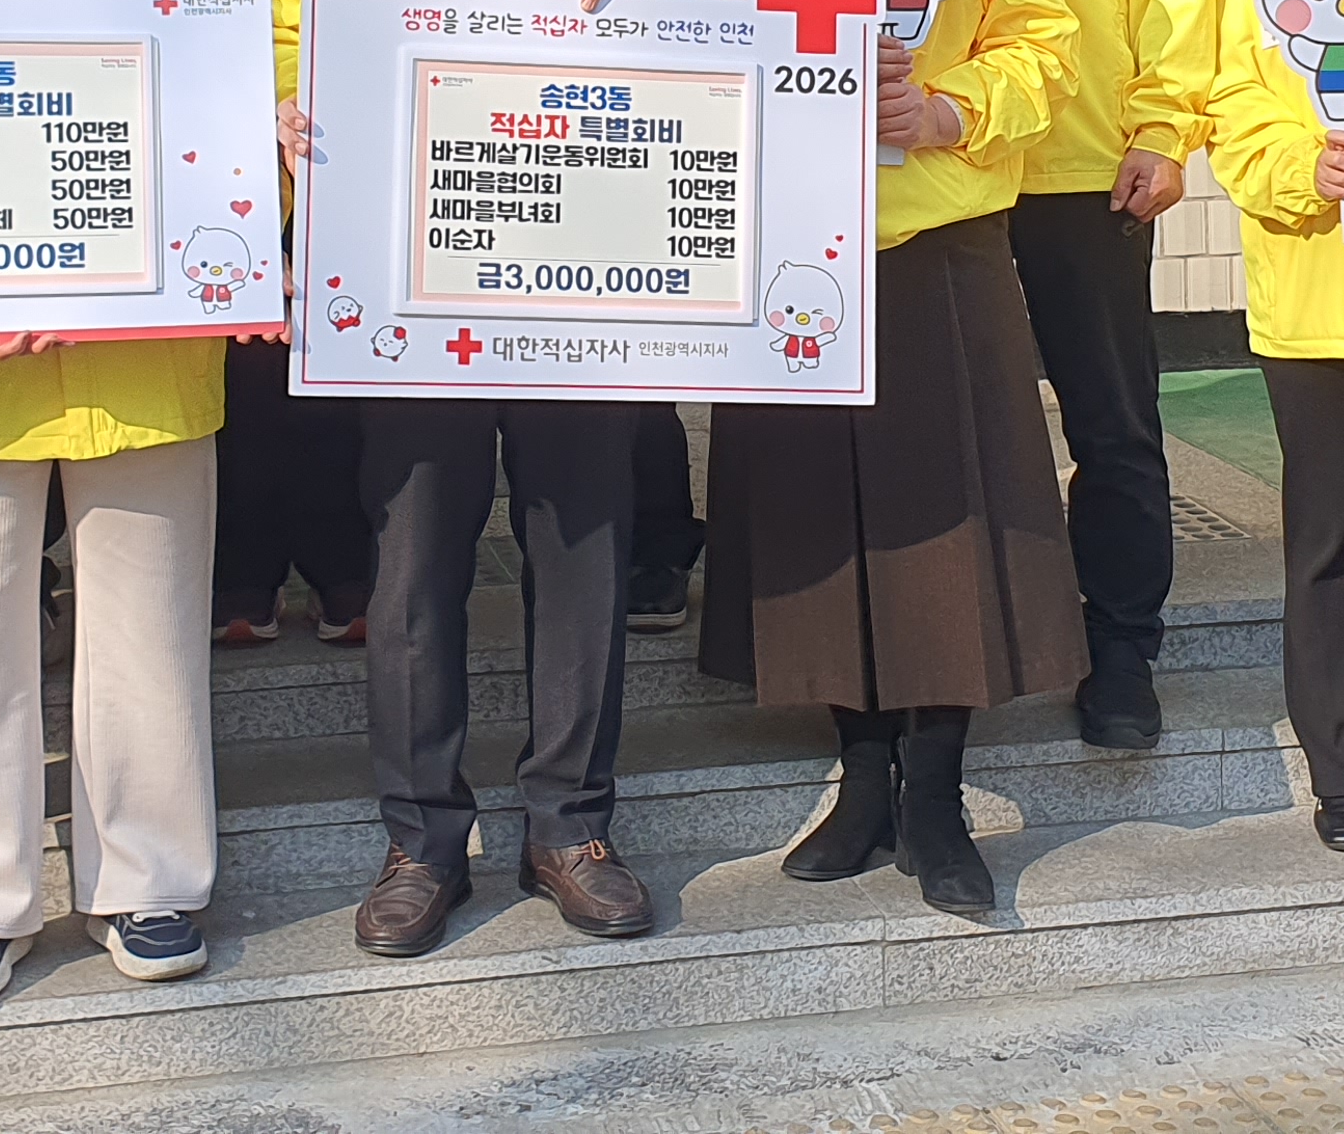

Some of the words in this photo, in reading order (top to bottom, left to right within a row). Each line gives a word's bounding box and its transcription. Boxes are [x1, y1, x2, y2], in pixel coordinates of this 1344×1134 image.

[400, 6, 458, 35] 생명을
[467, 10, 524, 36] 살리는
[531, 14, 588, 38] 적십자
[595, 16, 649, 40] 모두가
[656, 18, 712, 44] 안전한
[719, 21, 755, 46] 인천
[774, 65, 858, 96] 2026
[539, 83, 633, 112] 송현3동
[41, 120, 130, 145] 110만원
[489, 112, 570, 141] 적십자
[578, 115, 683, 145] 특별회비
[50, 149, 132, 173] 50만원
[430, 141, 650, 170] 바르게살기운동위원회
[669, 149, 738, 174] 10만원
[50, 178, 132, 202] 50만원
[429, 170, 562, 196] 새마을협의회
[667, 177, 737, 203] 10만원
[52, 207, 134, 231] 50만원
[428, 199, 562, 225] 새마을부녀회
[666, 206, 737, 231] 10만원
[428, 227, 496, 252] 이순자
[666, 235, 737, 260] 10만원
[476, 262, 691, 297] 금3,000,000원
[492, 335, 631, 364] 대한적십자사
[638, 340, 729, 360] 인천광역시지사
